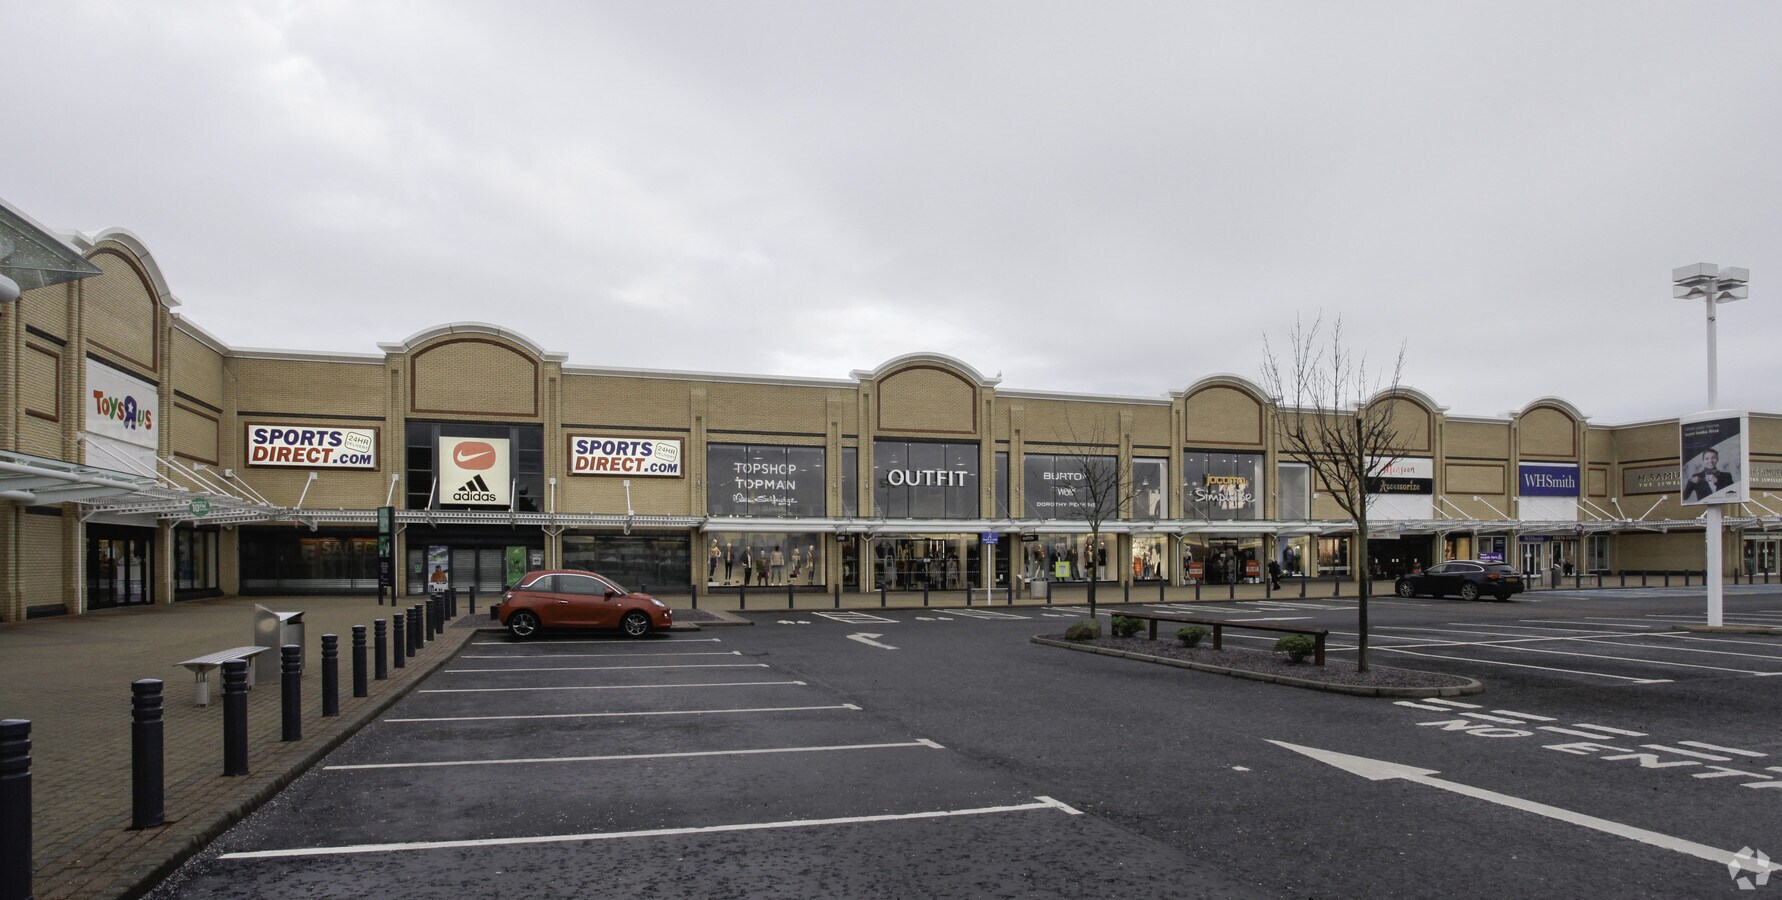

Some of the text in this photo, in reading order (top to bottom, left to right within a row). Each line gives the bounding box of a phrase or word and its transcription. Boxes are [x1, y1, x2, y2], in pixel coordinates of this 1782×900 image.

[253, 428, 343, 447] SPORTS
[348, 435, 369, 446] 24HR
[252, 446, 372, 465] DIRECT.COM
[575, 440, 653, 457] SPORTS
[657, 445, 676, 455] 24HR
[575, 456, 678, 473] DIRECT.COM
[734, 462, 797, 475] TOPSHOP
[888, 469, 968, 487] OUTFIT
[1524, 473, 1576, 488] WHSmith
[1638, 471, 1680, 482] H.SAMU
[735, 479, 796, 490] TOPMAN
[1379, 480, 1421, 493] Accessorize
[453, 490, 496, 501] adidas
[1415, 719, 1782, 789] NO ENT
